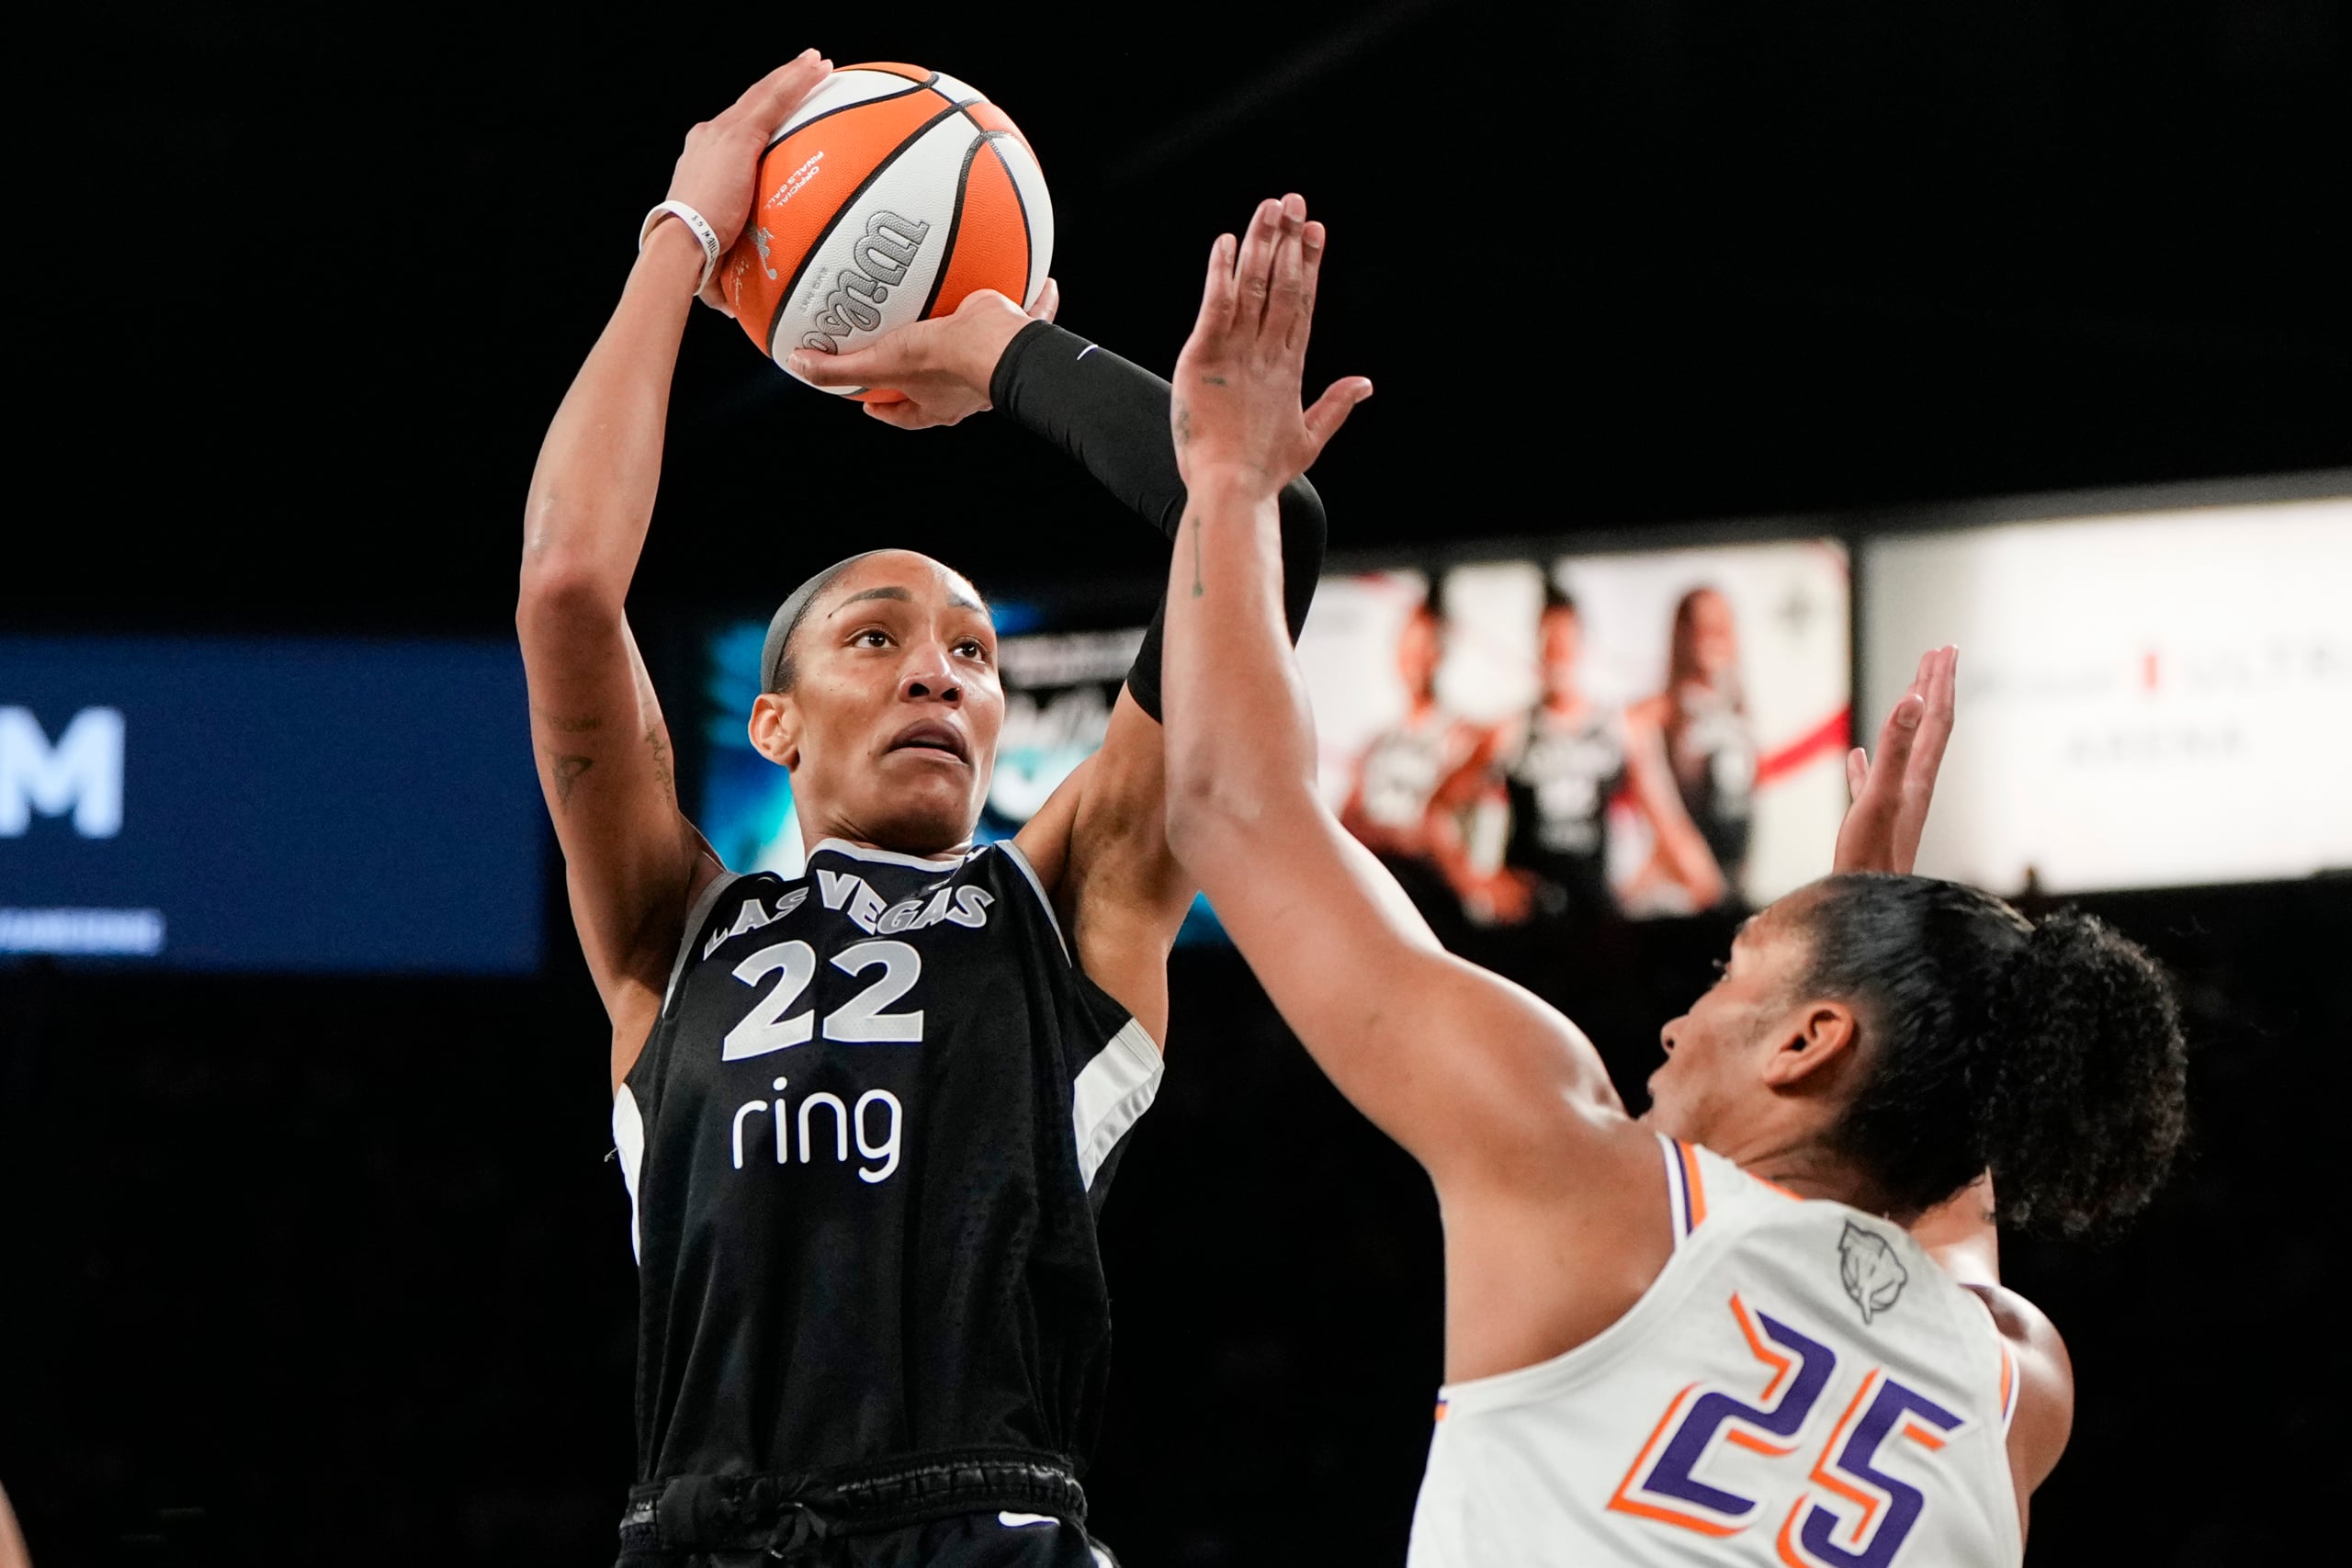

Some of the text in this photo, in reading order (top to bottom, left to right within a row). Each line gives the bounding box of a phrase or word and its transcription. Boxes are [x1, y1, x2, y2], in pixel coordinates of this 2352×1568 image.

[776, 165, 820, 207] OFFICIAL
[787, 150, 824, 185] FINALS
[801, 210, 930, 356] Wilso
[703, 868, 996, 962] LAS VEGAS
[722, 940, 924, 1062] 22
[732, 1076, 903, 1183] ring
[1605, 1291, 1966, 1568] 25
